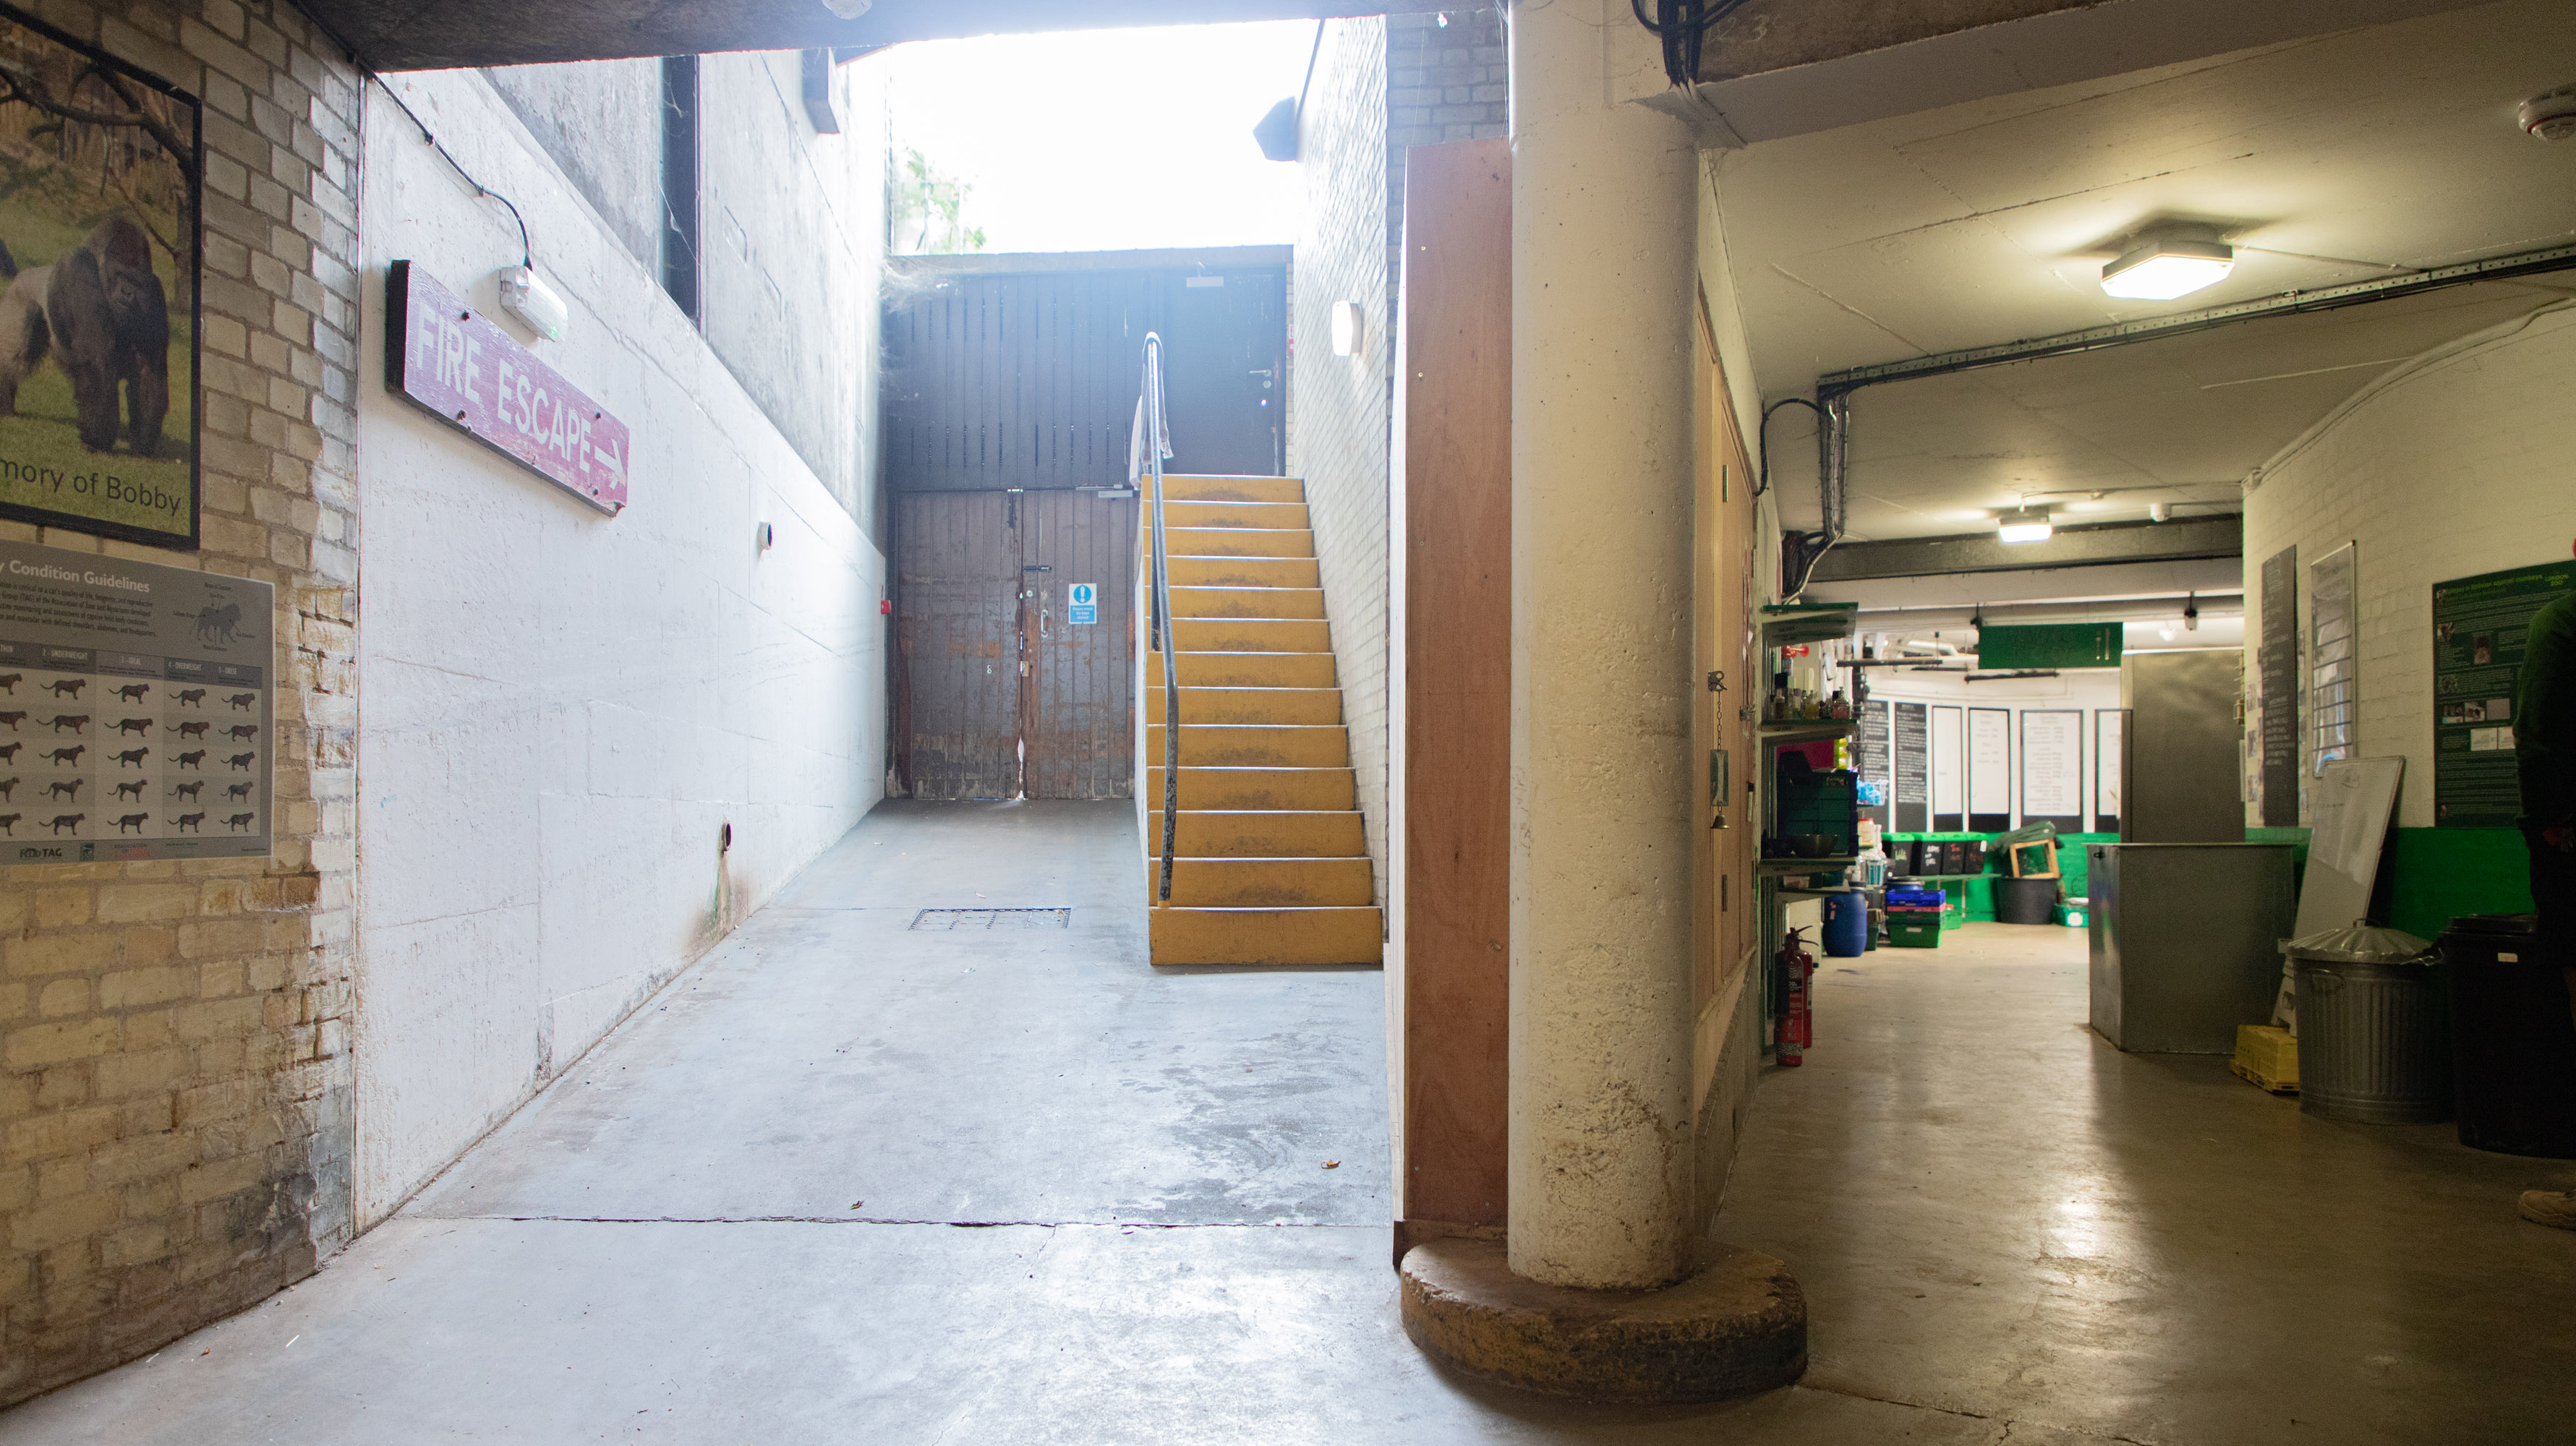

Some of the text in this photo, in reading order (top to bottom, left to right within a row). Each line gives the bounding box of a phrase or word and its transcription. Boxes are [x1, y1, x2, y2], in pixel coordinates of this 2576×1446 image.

[417, 302, 591, 474] FIRE ESCAPE
[74, 472, 99, 495] of
[108, 475, 181, 516] Bobby
[9, 560, 80, 582] Condition
[84, 571, 150, 592] Guidelines
[51, 650, 88, 659] UNDERWEIGHT
[176, 662, 202, 671] OVERWEIGHT
[43, 848, 61, 857] TAG
